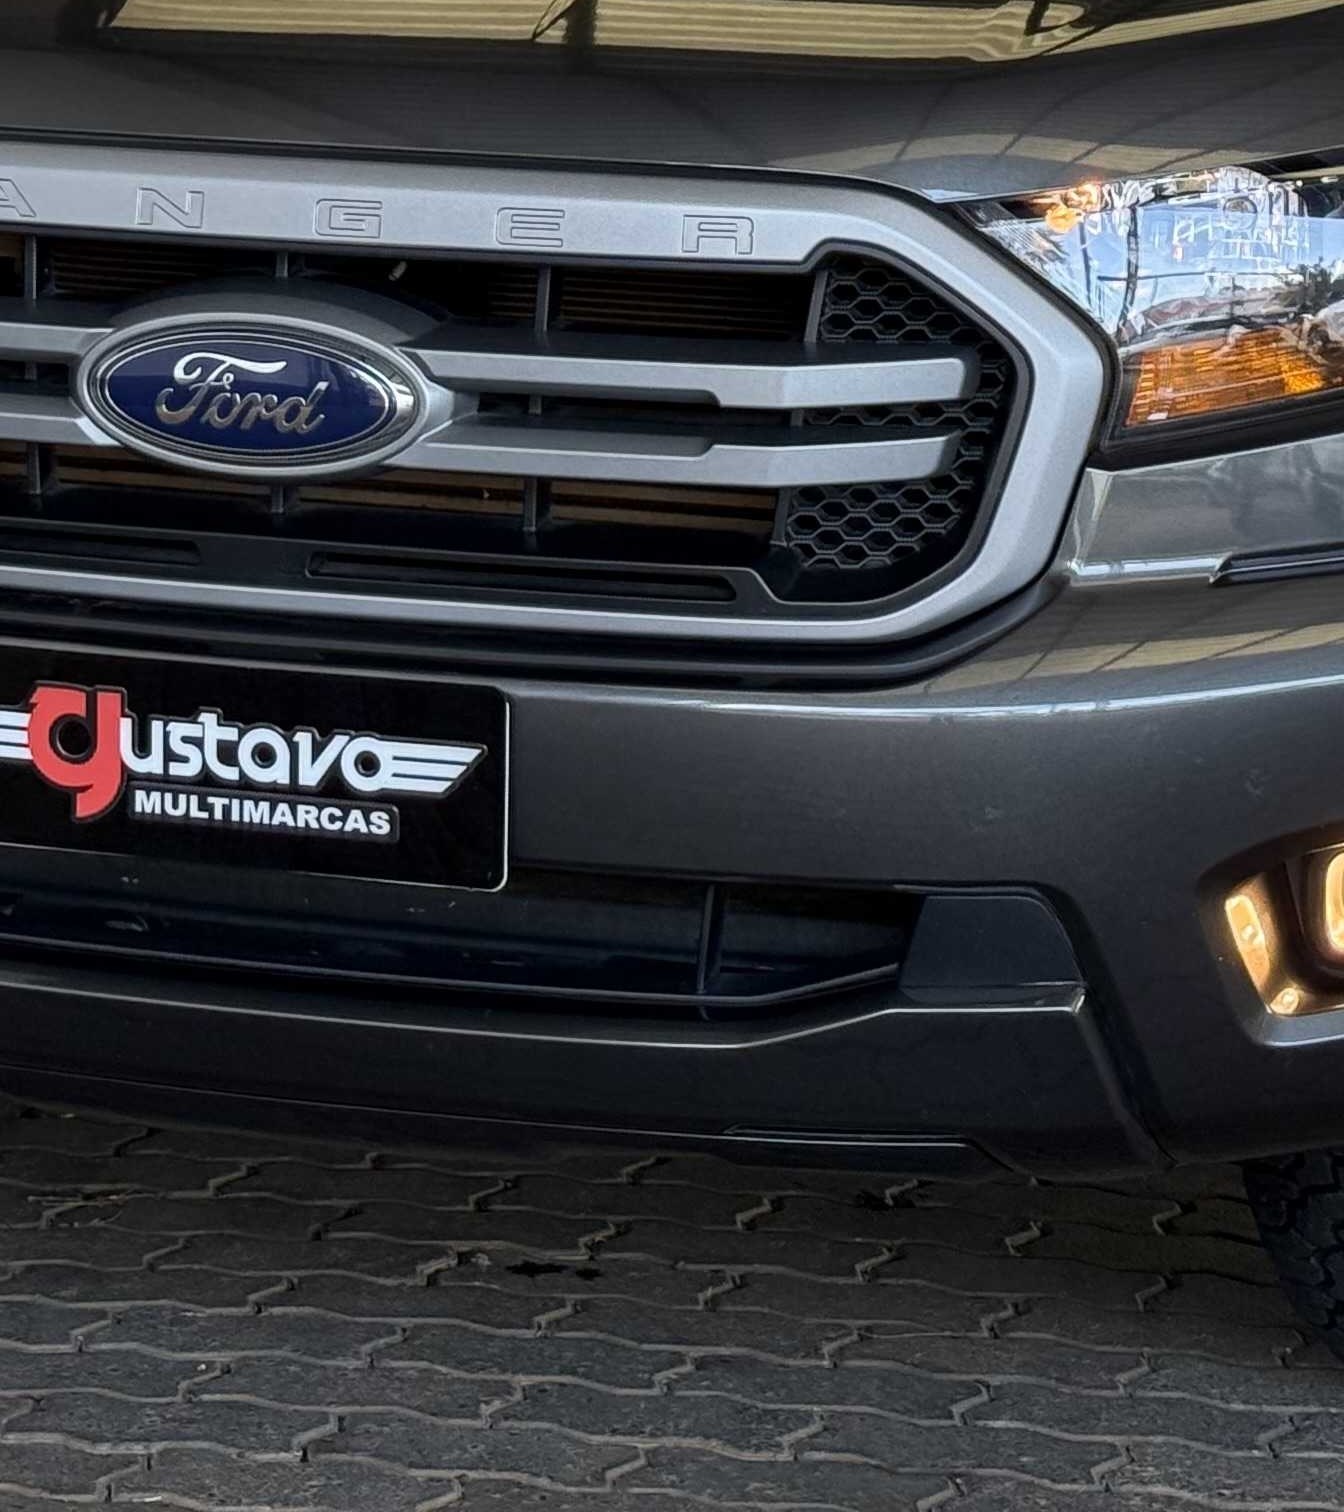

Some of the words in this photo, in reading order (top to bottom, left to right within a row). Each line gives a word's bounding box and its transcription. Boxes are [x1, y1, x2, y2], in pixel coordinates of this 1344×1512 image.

[156, 352, 329, 434] Ford
[26, 685, 394, 819] gustavo
[134, 788, 392, 835] MULTIMARCAS
